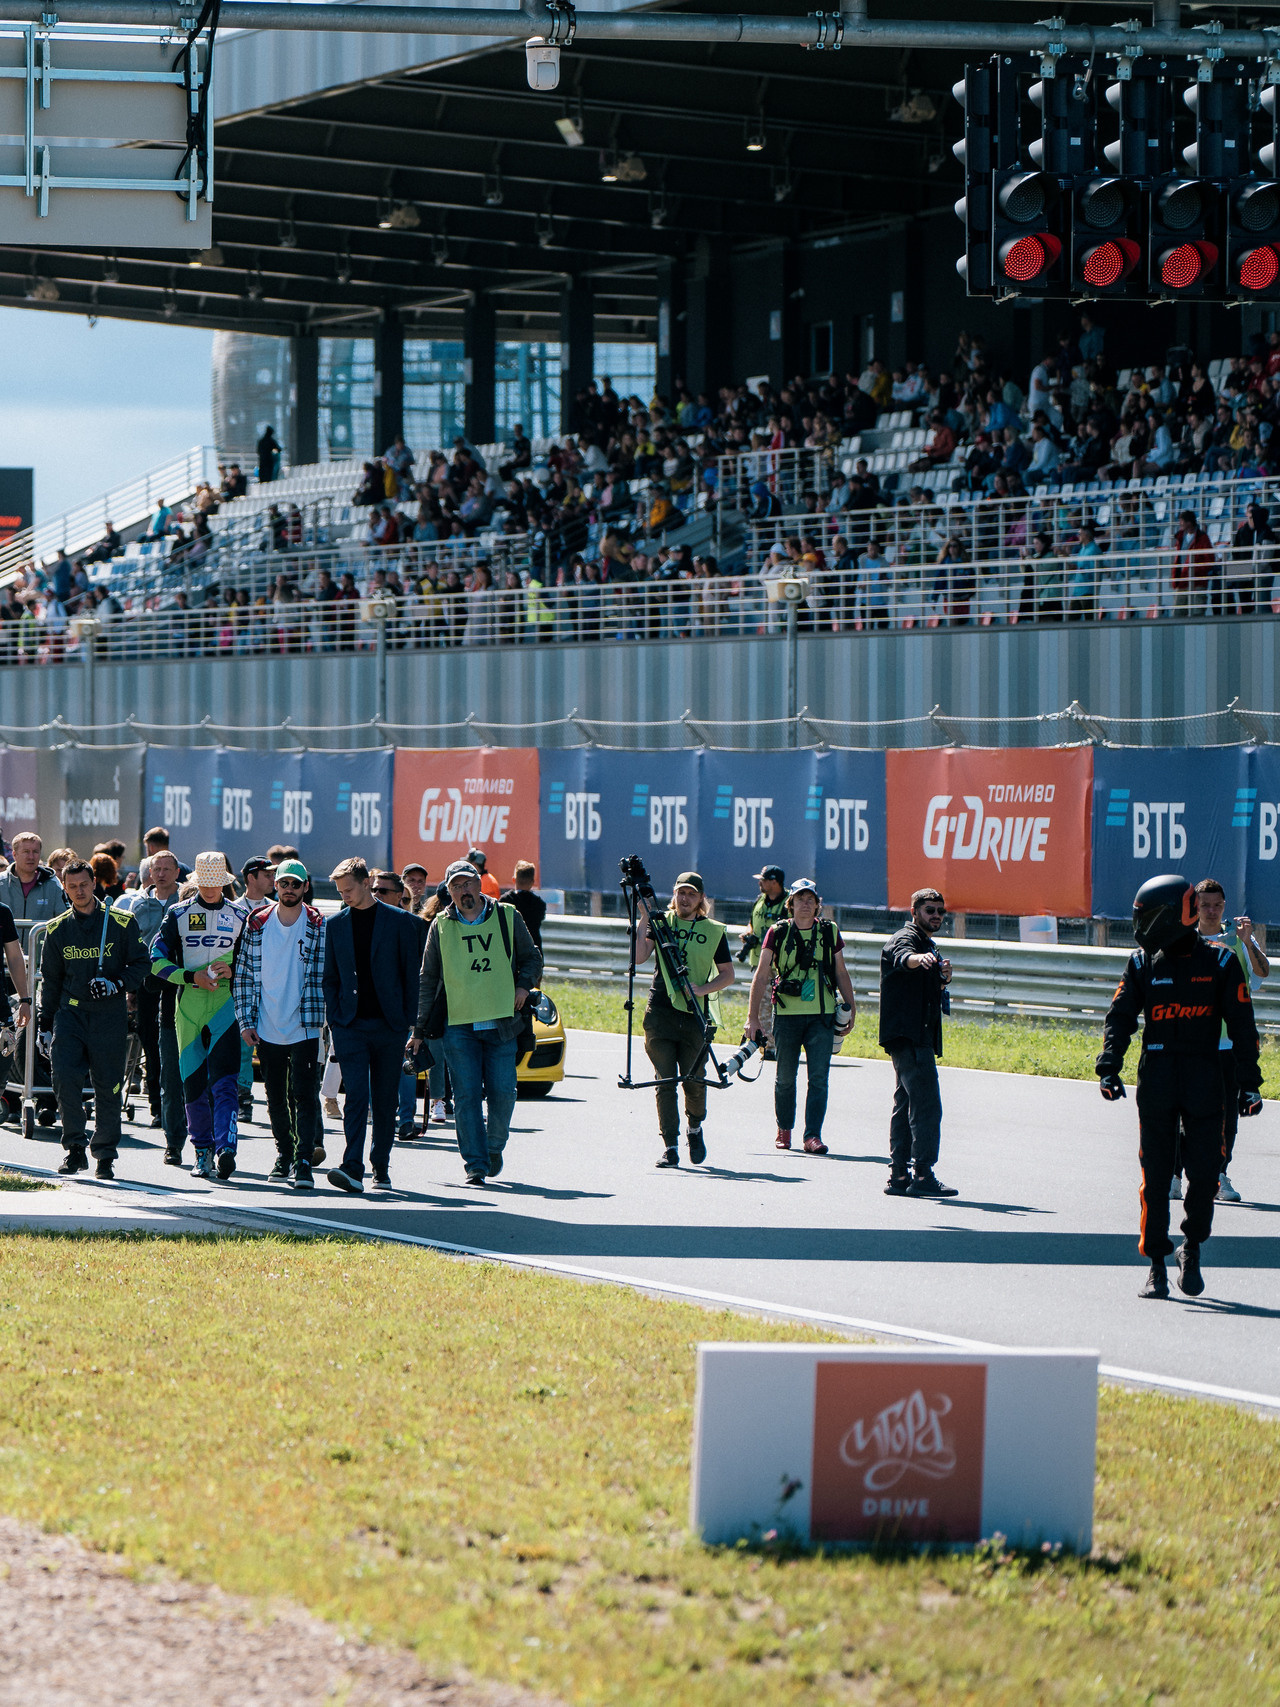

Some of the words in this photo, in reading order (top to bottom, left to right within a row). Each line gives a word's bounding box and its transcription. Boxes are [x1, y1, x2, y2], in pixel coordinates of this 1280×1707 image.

[164, 786, 192, 827] ВТБ
[464, 778, 514, 794] ТОПЛИВО
[988, 784, 1056, 803] ТОПЛИВО
[223, 788, 253, 831] ВТБ
[283, 791, 313, 834] ВТБ
[351, 792, 381, 836] ВТБ
[565, 793, 601, 840] ВТБ
[650, 796, 688, 844] ВТБ
[734, 797, 774, 848] ВТБ
[825, 799, 869, 851] ВТБ
[1133, 802, 1187, 859] ВТБ
[185, 935, 234, 948] SED
[462, 933, 493, 953] TV
[471, 958, 492, 972] 42
[228, 1110, 238, 1145] SED
[862, 1498, 928, 1517] DRIVE
